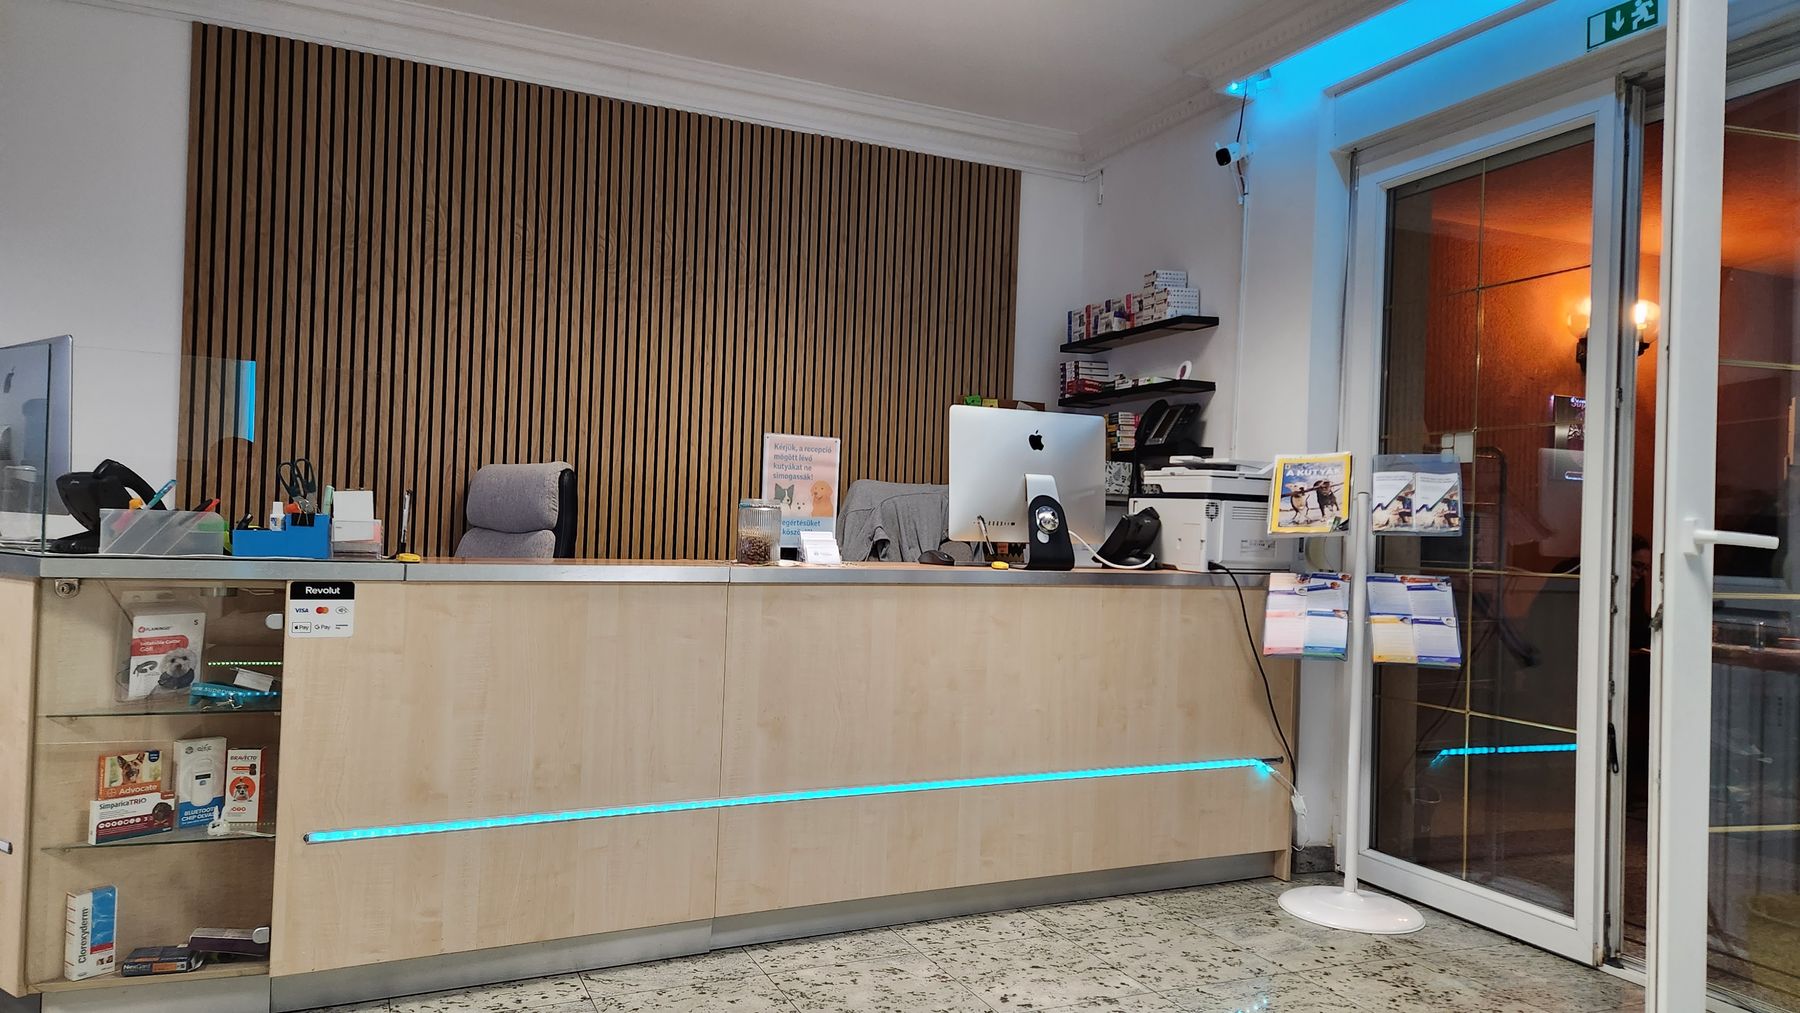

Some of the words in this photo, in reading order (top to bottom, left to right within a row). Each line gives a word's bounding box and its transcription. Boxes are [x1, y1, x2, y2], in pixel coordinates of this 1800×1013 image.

[774, 443, 798, 453] Kérjük,
[804, 445, 832, 455] recepció
[773, 453, 798, 462] mögött
[773, 462, 803, 473] kutyákat
[773, 473, 814, 482] simogassák!
[305, 586, 341, 595] Revolut
[119, 784, 158, 795] Advocate
[184, 806, 214, 817] BLUETOOT
[78, 907, 89, 964] Cloroxyderm
